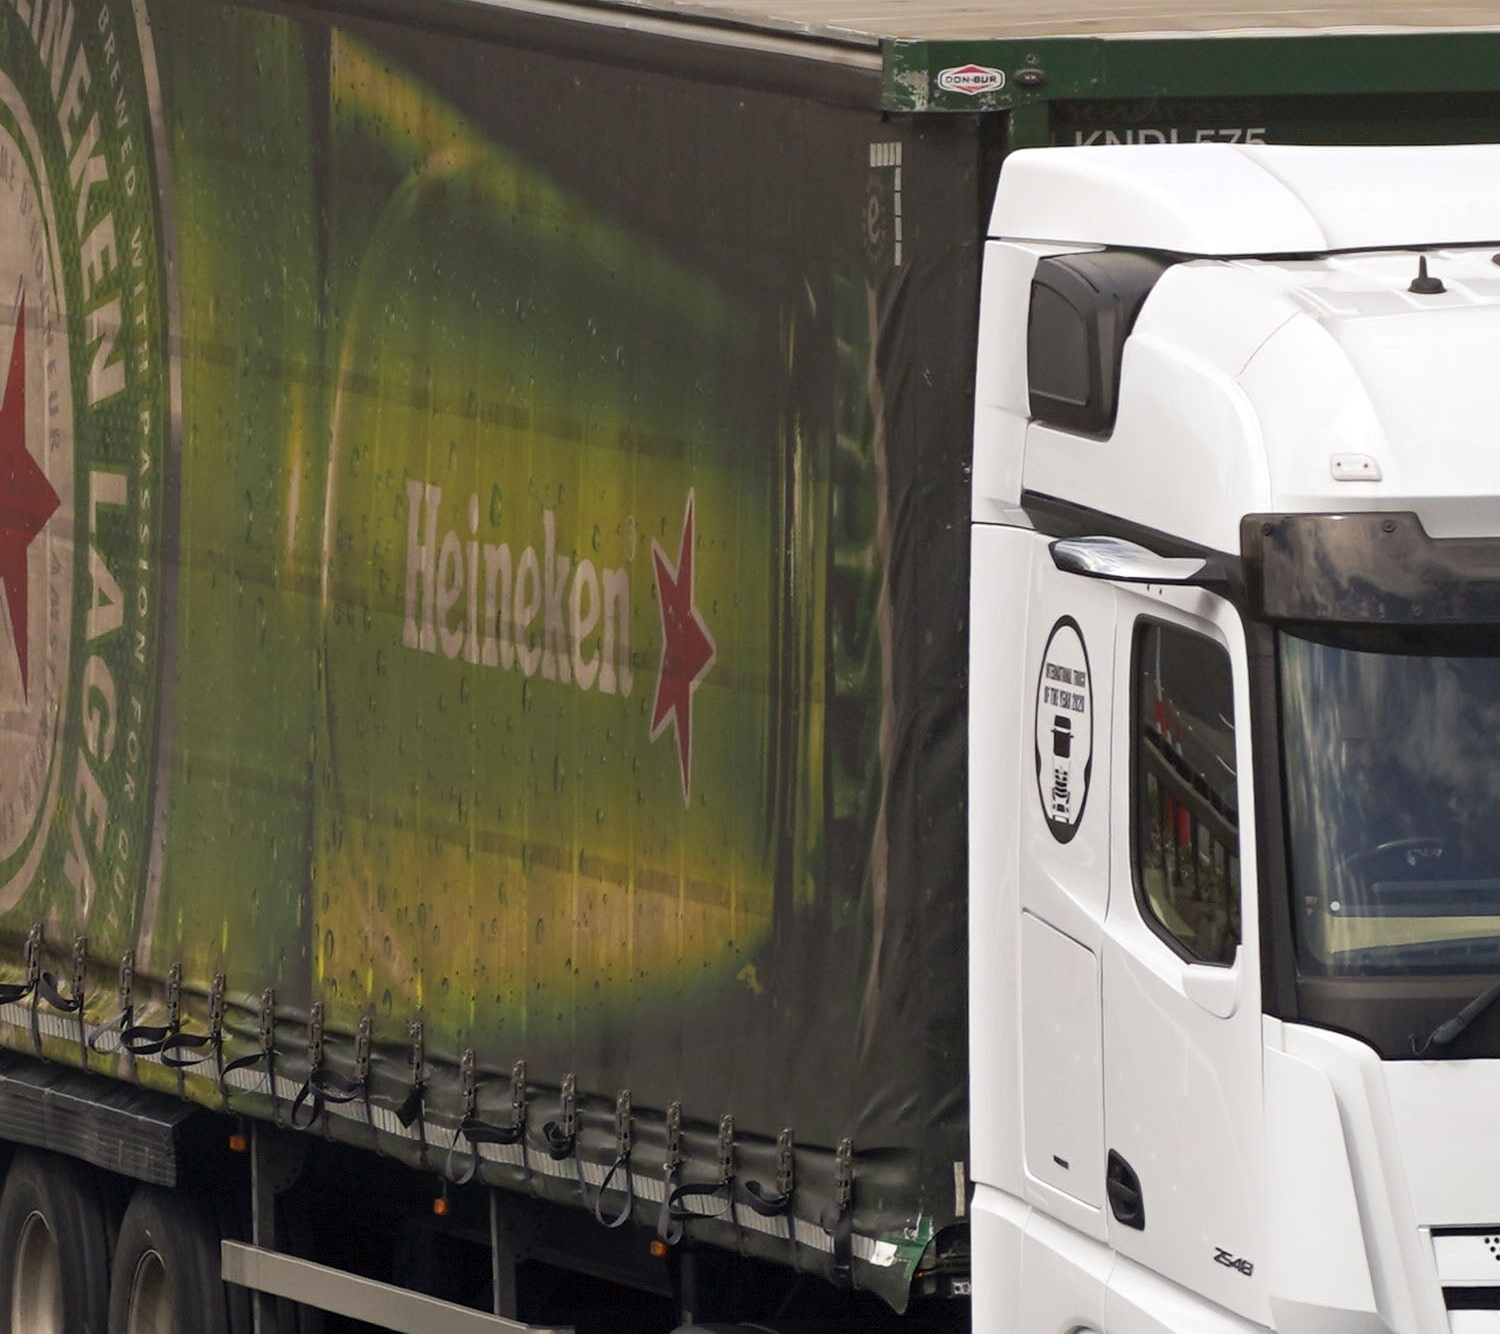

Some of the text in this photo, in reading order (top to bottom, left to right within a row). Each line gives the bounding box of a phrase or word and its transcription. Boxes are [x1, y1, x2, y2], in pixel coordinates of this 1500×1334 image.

[97, 3, 134, 197] BREWED
[944, 72, 999, 86] DON-BUR
[130, 225, 149, 372] WITH
[130, 409, 152, 666] PASSION
[402, 479, 633, 698] Heineken
[62, 468, 128, 925] LAGER
